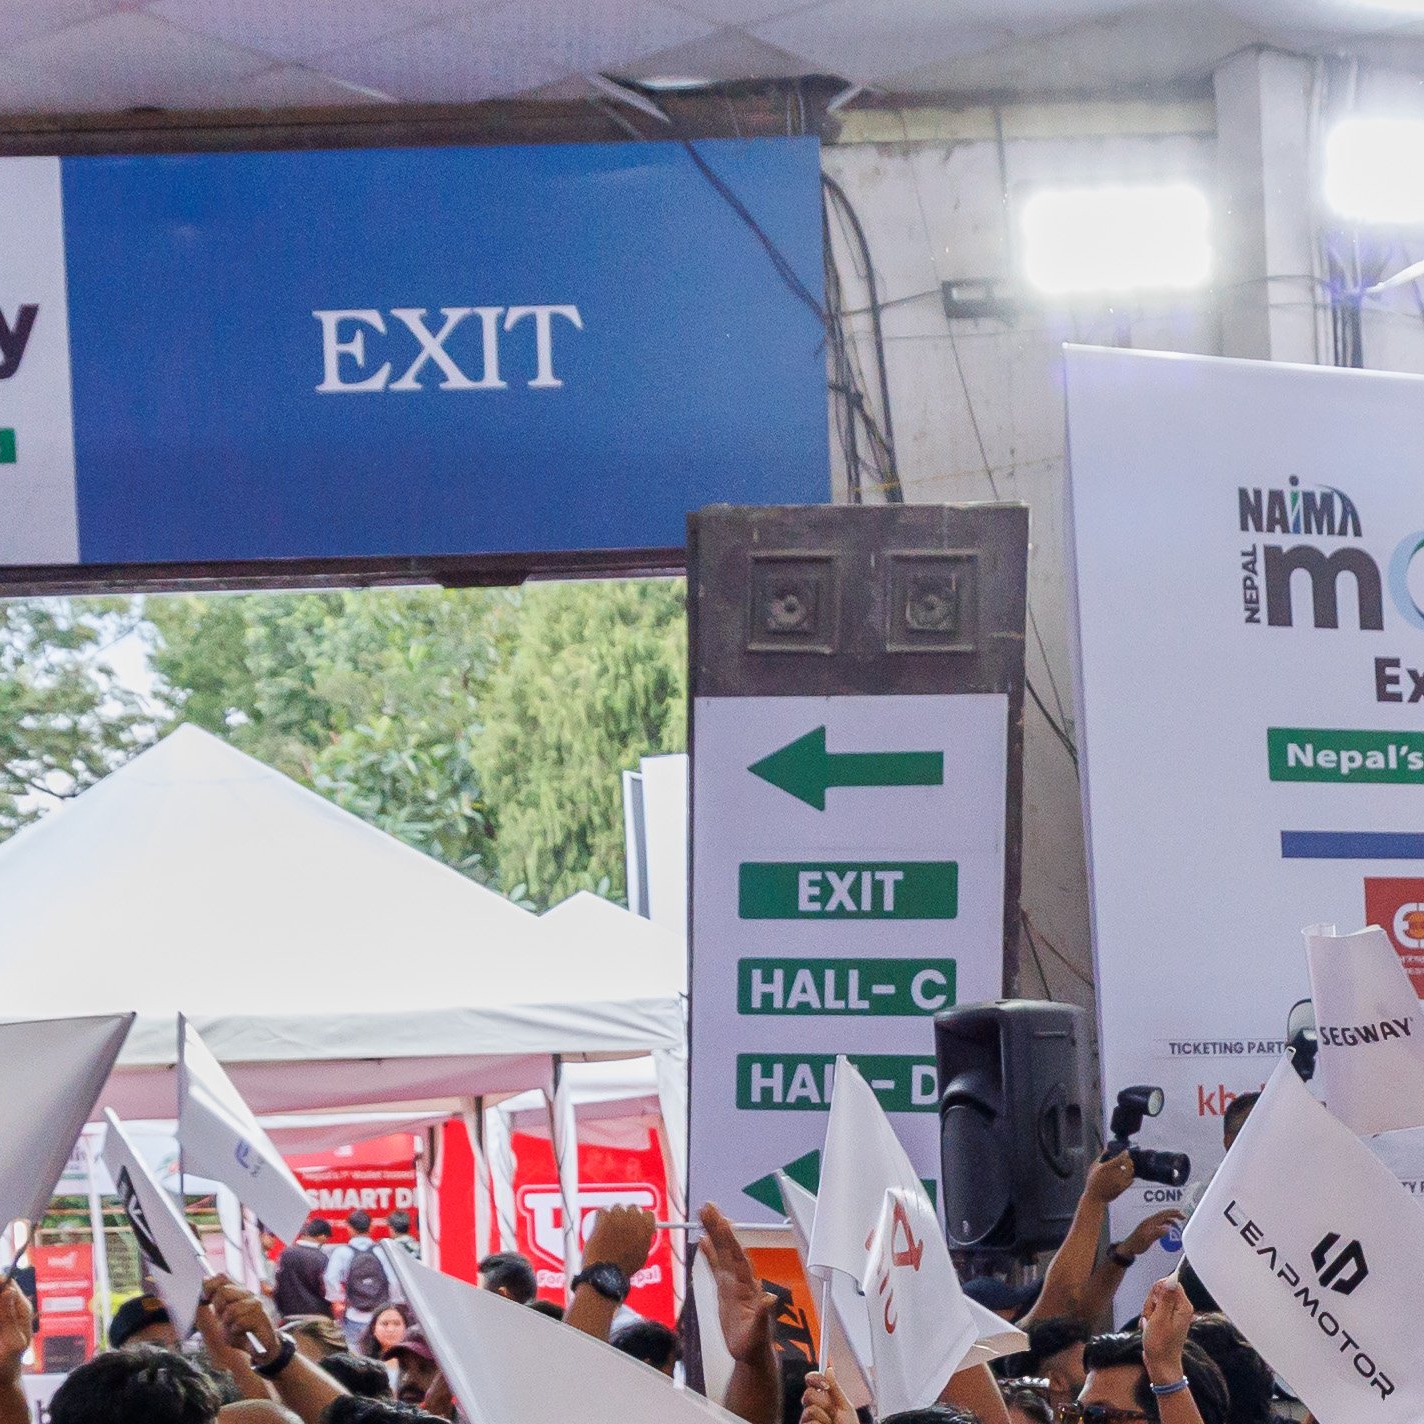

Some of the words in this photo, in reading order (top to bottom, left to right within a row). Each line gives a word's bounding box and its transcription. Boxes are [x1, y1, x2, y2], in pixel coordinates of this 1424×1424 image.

[312, 305, 583, 393] EXIT
[1241, 543, 1261, 624] NEPAL
[1286, 743, 1424, 773] Nepal's
[797, 870, 904, 912] EXIT
[1169, 1041, 1244, 1056] TICKETING
[1247, 1041, 1286, 1054] PART
[1319, 1016, 1413, 1049] SEGWAY
[1223, 1200, 1396, 1401] LEAPMOTOR
